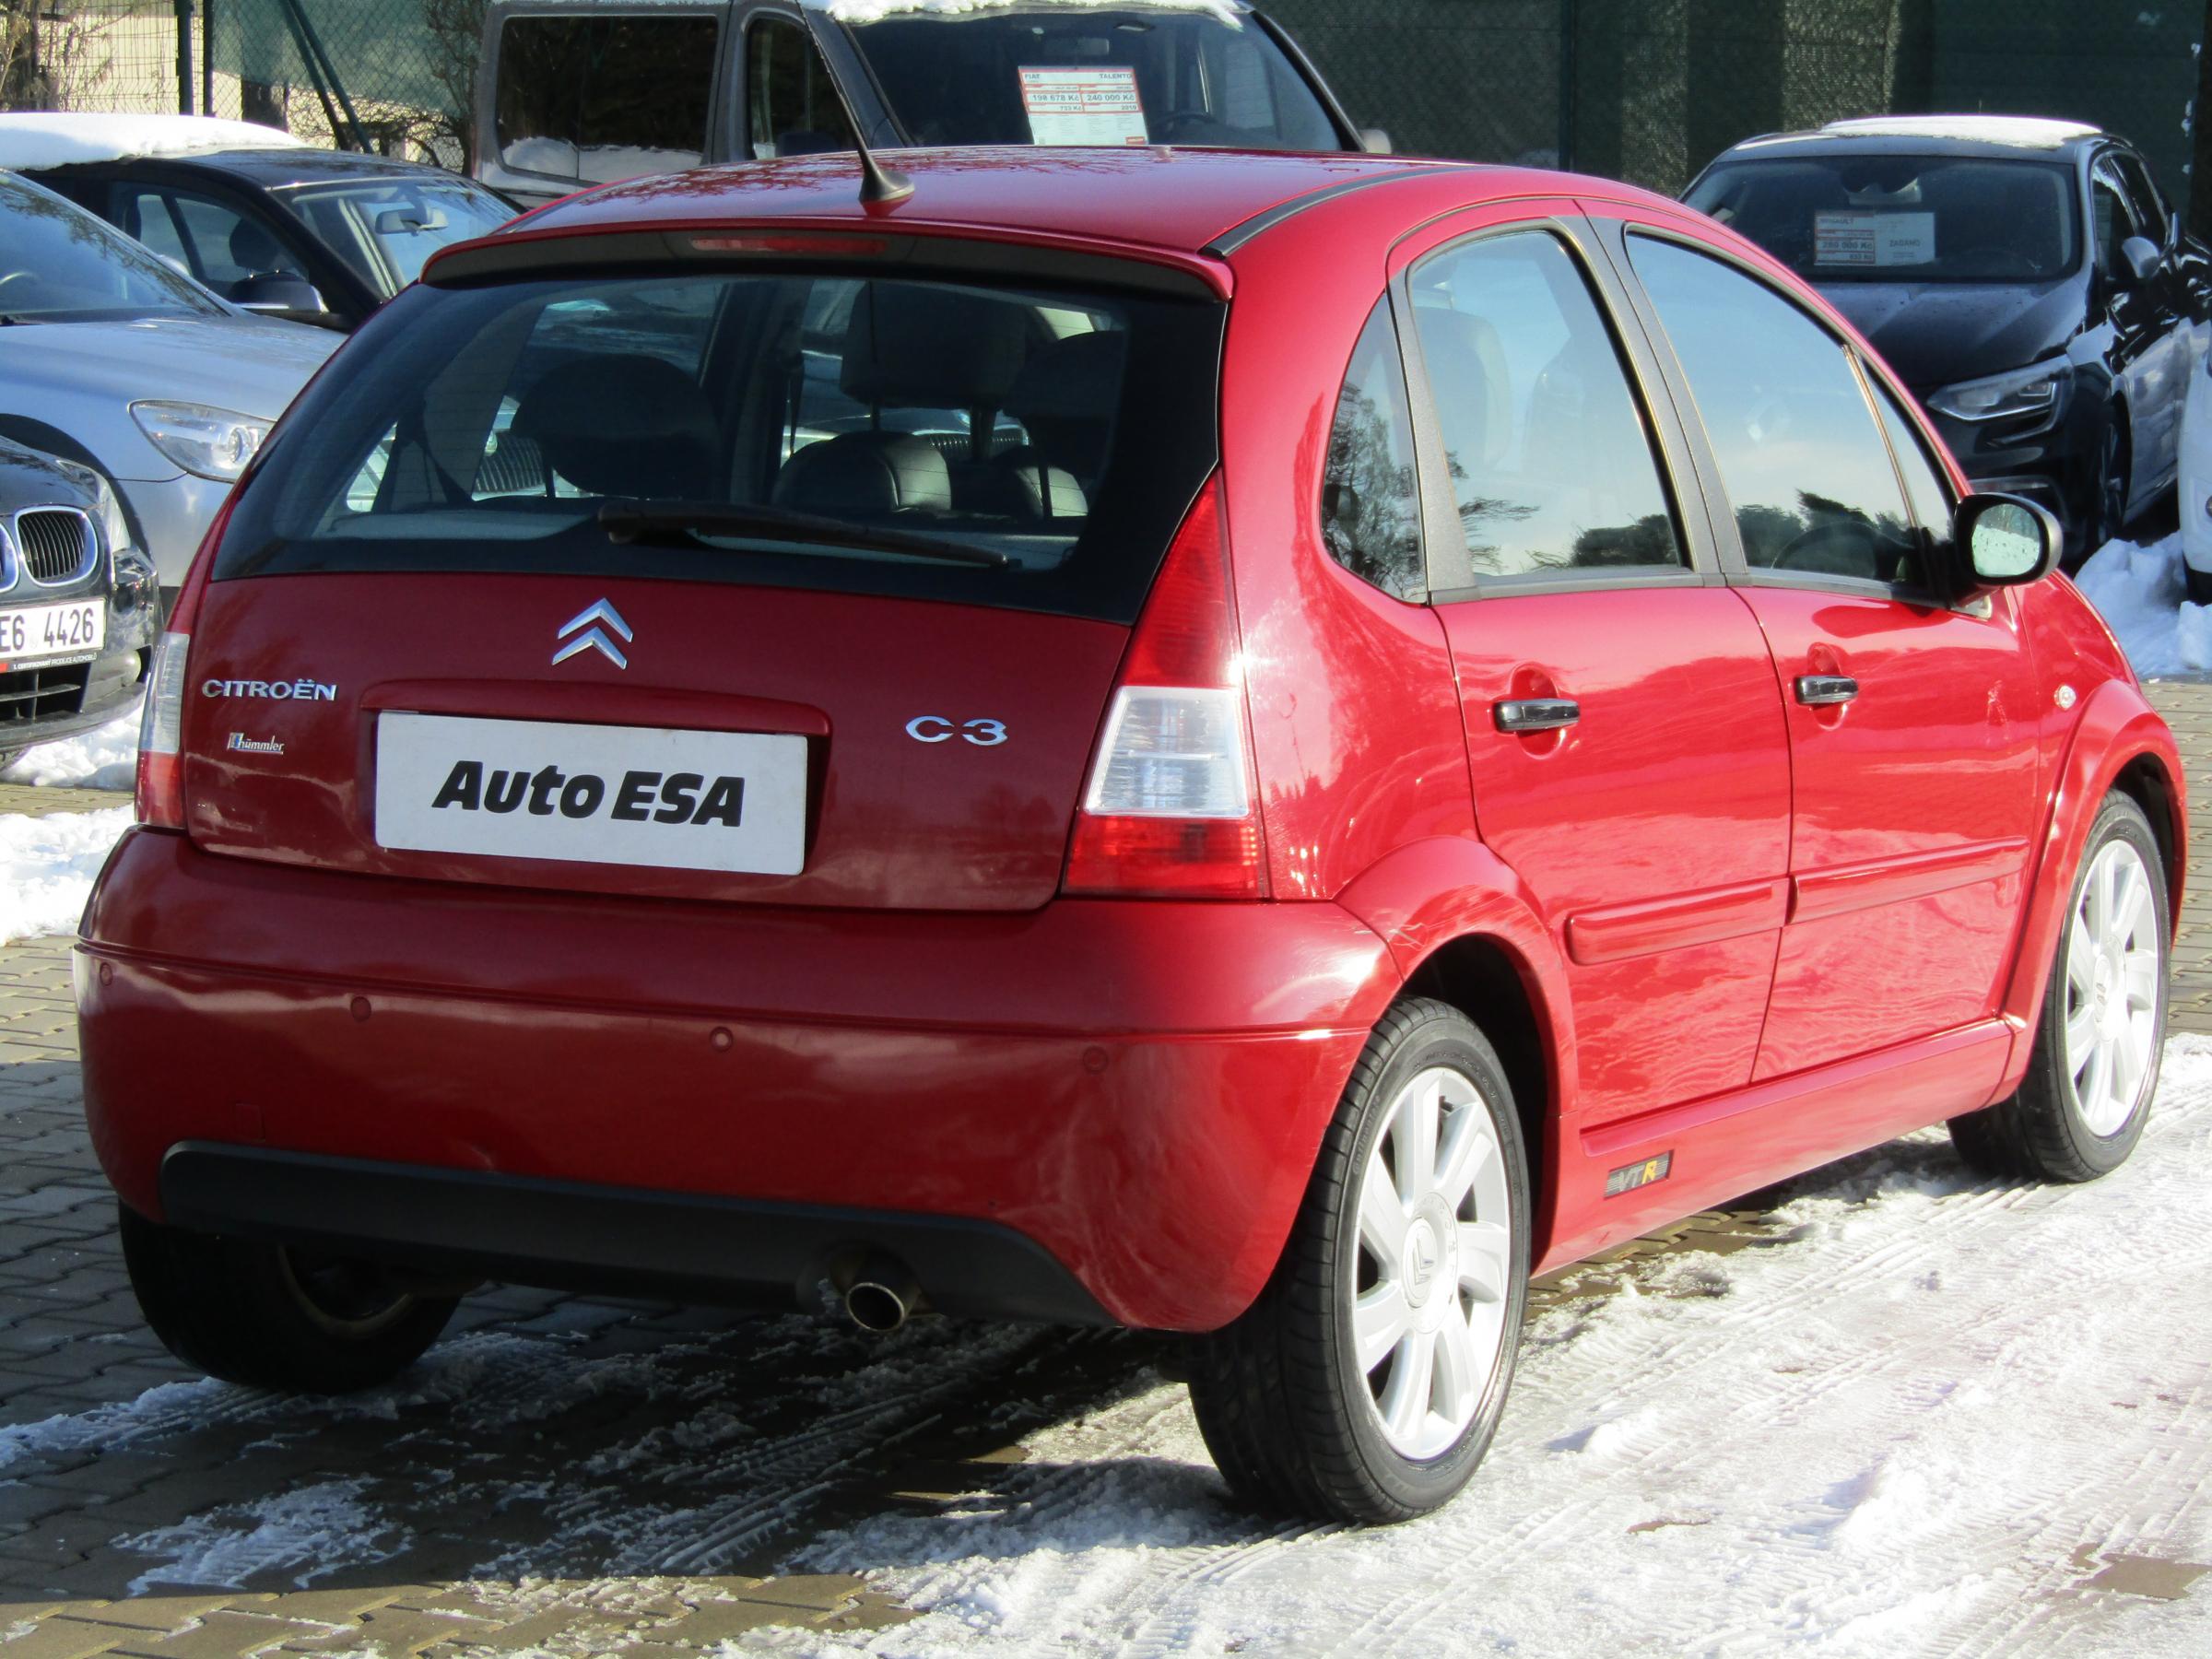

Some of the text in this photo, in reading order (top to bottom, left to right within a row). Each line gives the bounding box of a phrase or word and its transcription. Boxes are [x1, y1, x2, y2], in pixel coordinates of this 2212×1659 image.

[43, 607, 94, 649] 4426
[202, 678, 337, 701] CITROËN
[905, 715, 1008, 746] C3
[431, 760, 746, 827] Auto ESA
[1618, 1159, 1657, 1192] VTR
